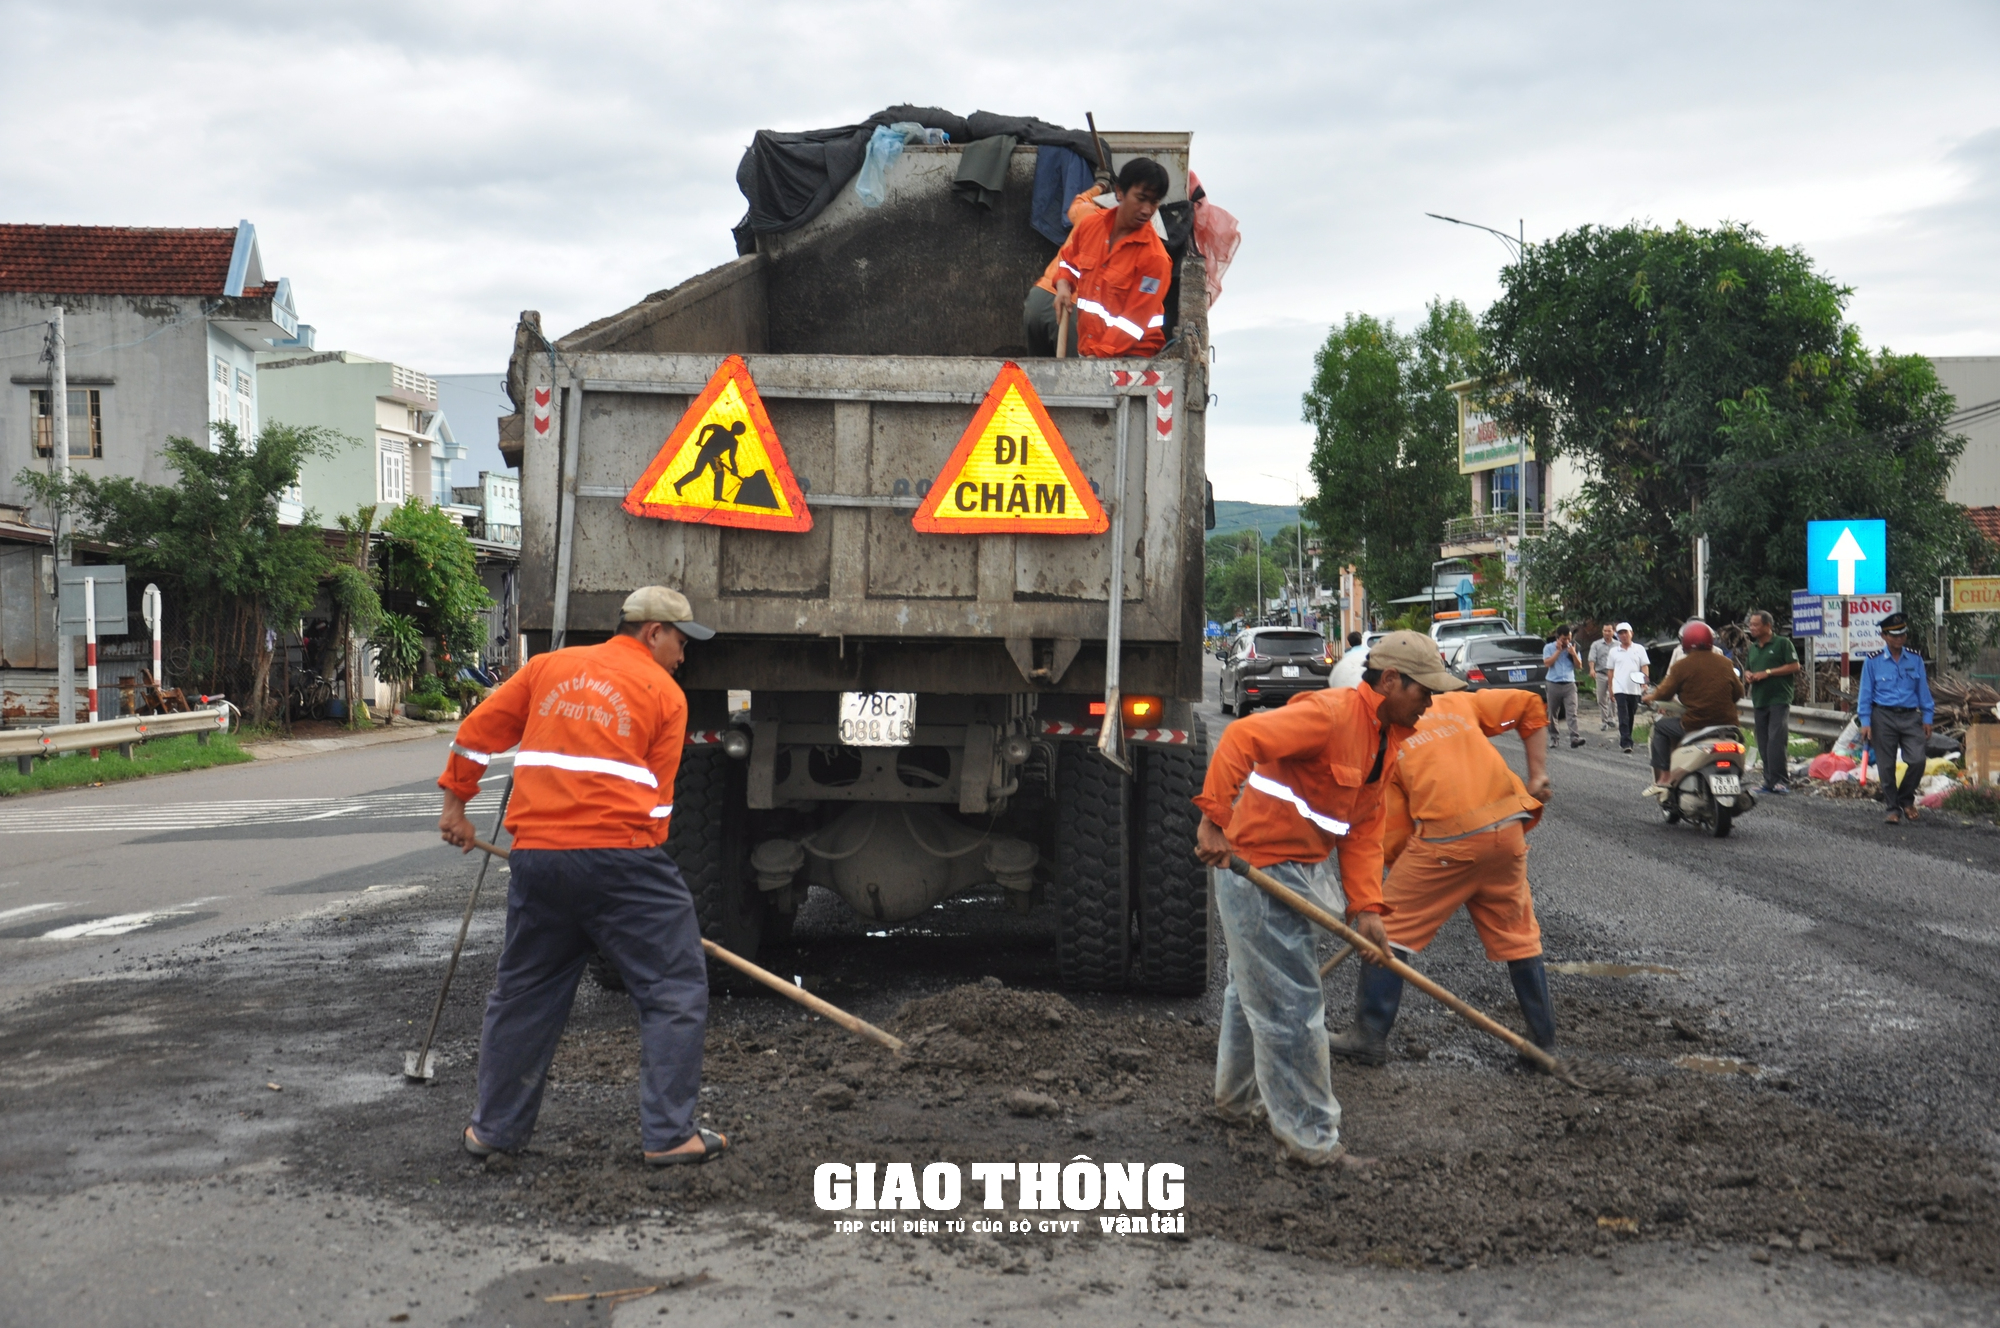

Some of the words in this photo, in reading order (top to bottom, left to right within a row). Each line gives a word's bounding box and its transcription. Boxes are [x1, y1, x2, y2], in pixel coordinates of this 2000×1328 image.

[994, 435, 1028, 465] ĐI
[955, 474, 1066, 518] CHẬM
[1850, 597, 1893, 614] BÔNG
[557, 680, 570, 694] TY
[554, 700, 585, 720] PHÚ
[586, 705, 614, 728] YÊN
[858, 694, 897, 717] 78C
[1405, 729, 1434, 749] PHÚ
